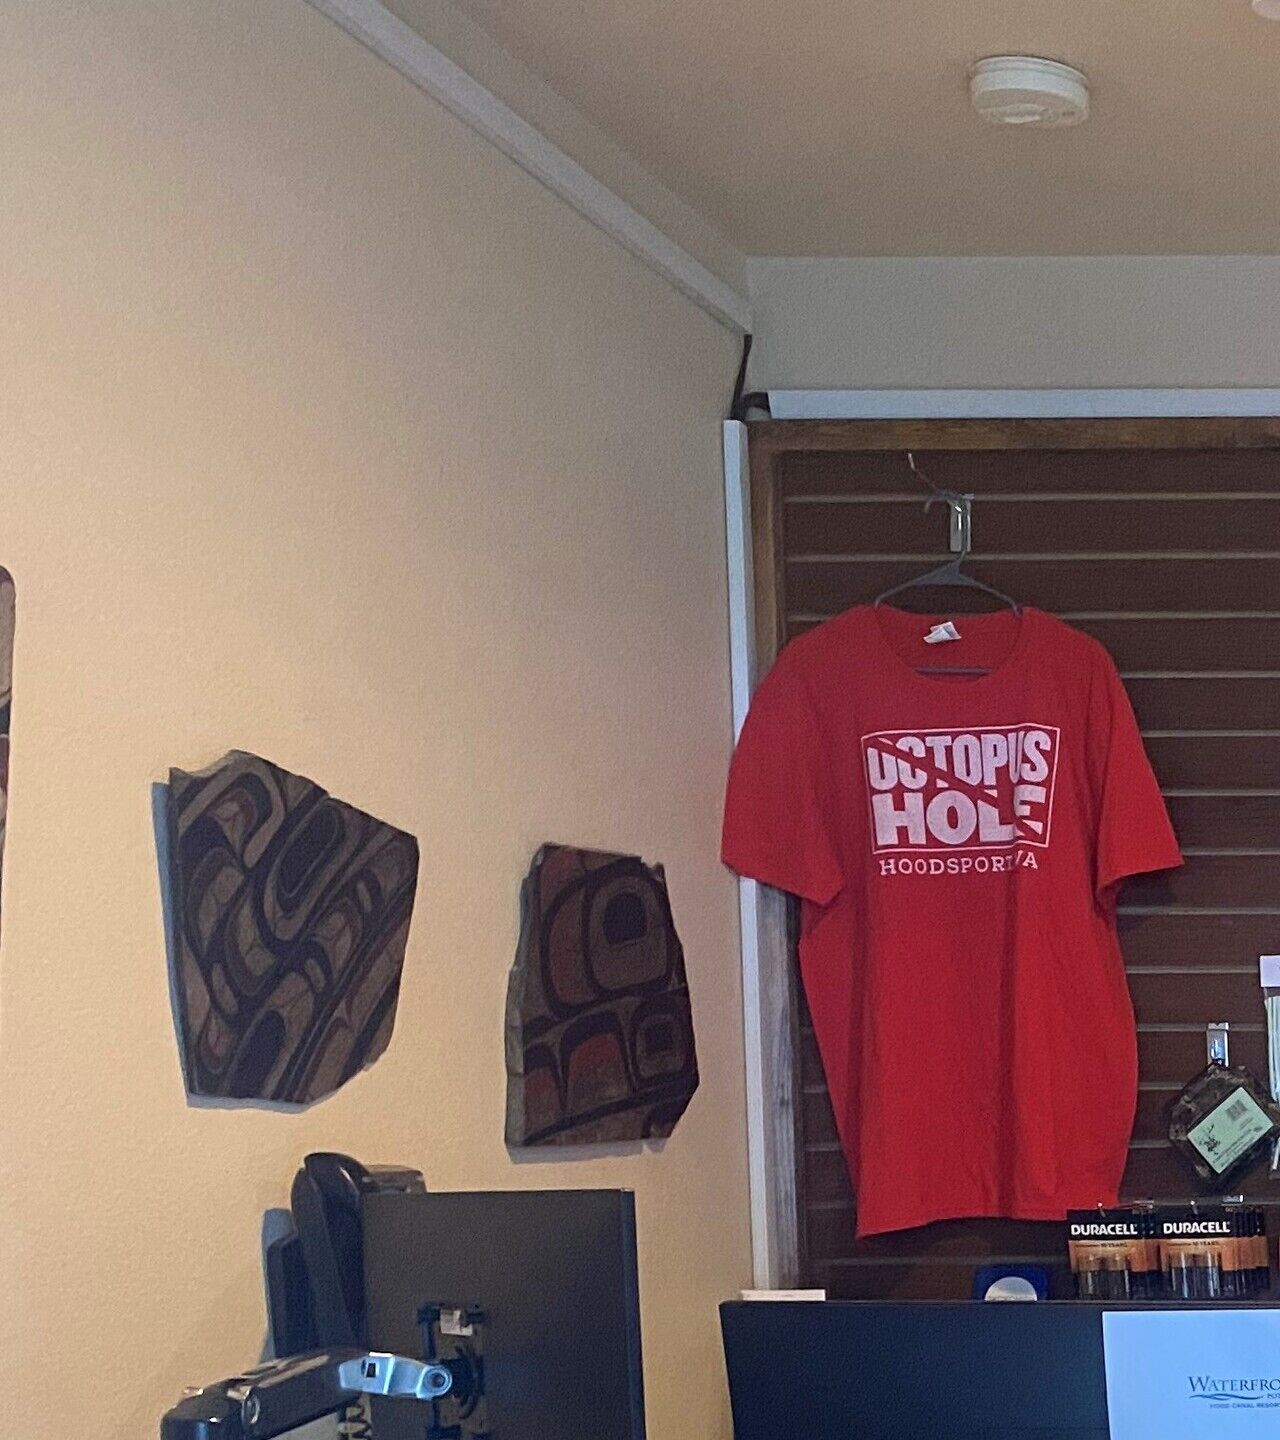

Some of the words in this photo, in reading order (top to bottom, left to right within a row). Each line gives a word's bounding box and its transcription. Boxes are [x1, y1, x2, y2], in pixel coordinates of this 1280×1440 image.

[867, 730, 1052, 790] OCTOPUS
[872, 784, 1047, 846] HOLE
[1071, 1224, 1138, 1236] DURACELL
[1163, 1221, 1231, 1234] DURACELL
